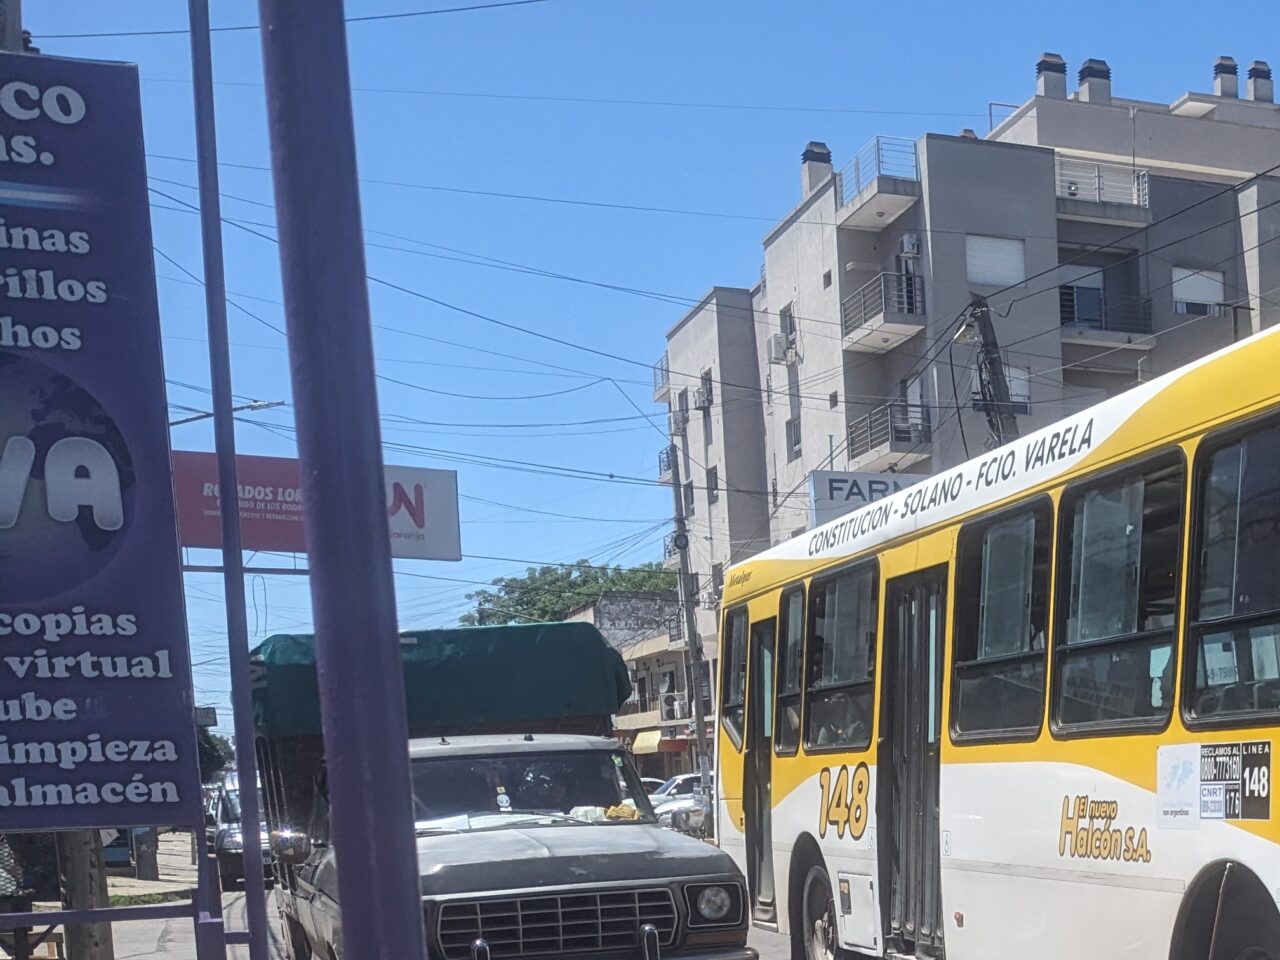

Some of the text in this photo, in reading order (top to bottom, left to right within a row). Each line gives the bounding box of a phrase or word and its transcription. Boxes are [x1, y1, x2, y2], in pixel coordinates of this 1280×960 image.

[0, 266, 107, 304] illos
[808, 501, 893, 556] CONSTITUCION
[901, 472, 963, 519] SOLANO
[975, 450, 1016, 491] FCIO.
[1025, 418, 1094, 472] VARELA
[3, 648, 174, 679] virtual
[1201, 745, 1240, 756] RECLAMOS AL
[1243, 744, 1269, 755] LINEA
[1202, 787, 1222, 798] CNRT
[1244, 766, 1268, 797] 148
[819, 761, 870, 841] 148
[1078, 795, 1118, 820] El nuevo
[1226, 791, 1240, 815] 176
[1059, 795, 1151, 863] Halcón S.A.
